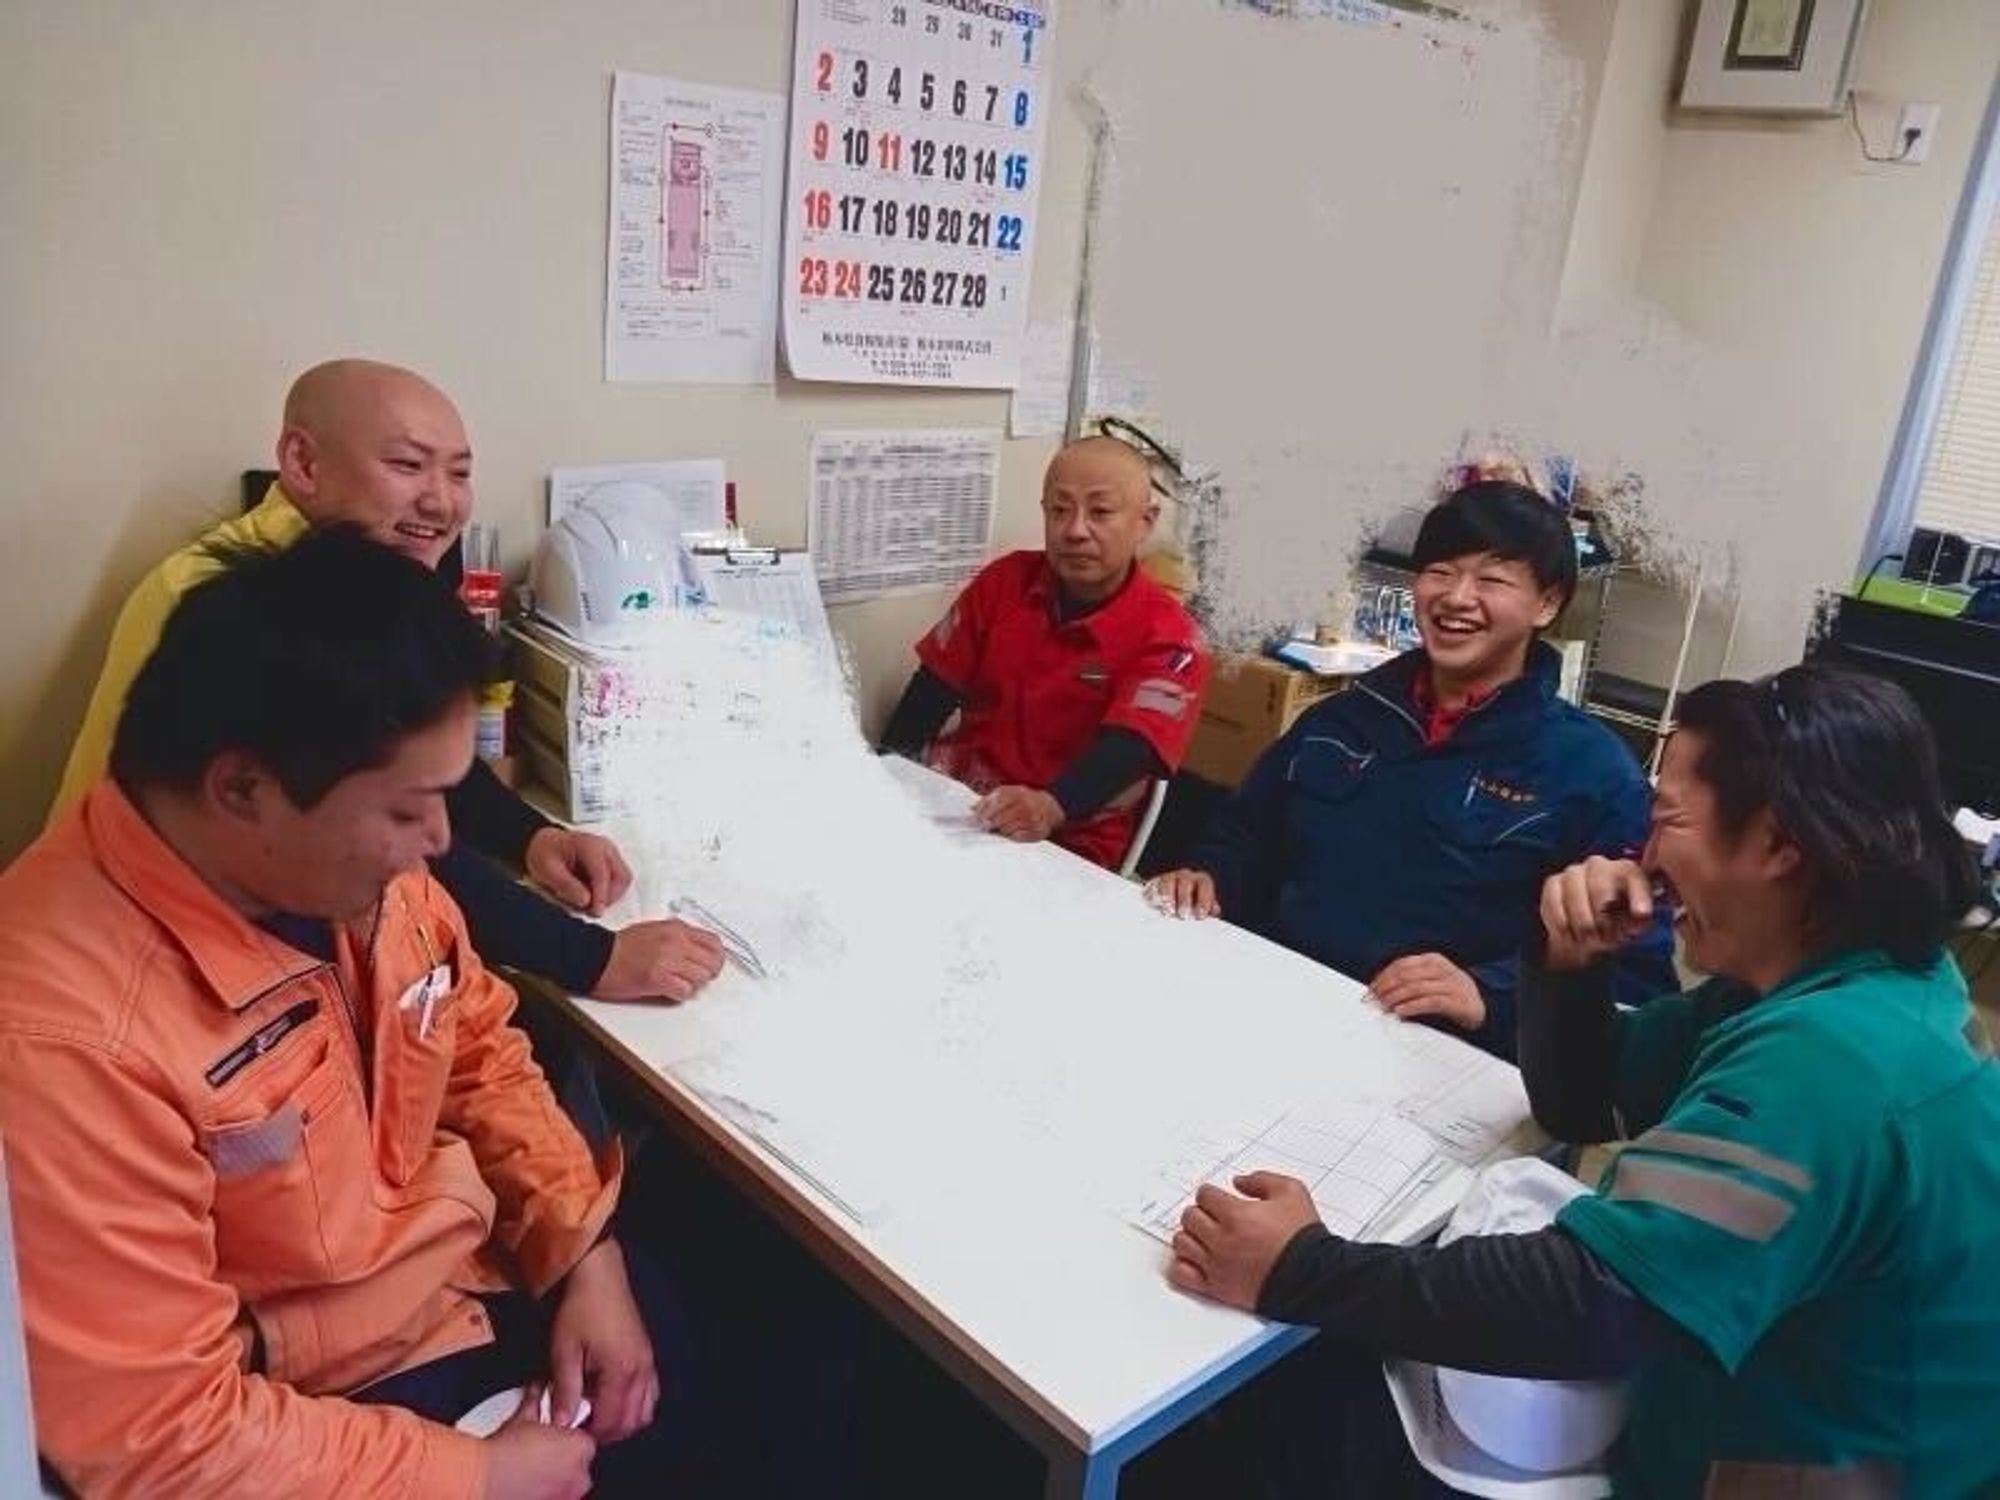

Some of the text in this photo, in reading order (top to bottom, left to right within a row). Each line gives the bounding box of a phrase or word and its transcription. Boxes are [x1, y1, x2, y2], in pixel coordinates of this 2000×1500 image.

[892, 7, 906, 27] 28
[925, 15, 940, 34] 29
[957, 22, 972, 41] 30
[990, 30, 1003, 48] 31
[1022, 29, 1034, 63] 1
[817, 53, 1029, 126] 2 3 4 5 6 7 8
[813, 122, 1028, 190] 9 10 11 12 13 14 15
[804, 191, 1022, 251] 16 17 18 19 20 21 22
[800, 257, 828, 296] 23
[834, 262, 861, 299] 24
[867, 265, 895, 301] 25
[899, 268, 927, 304] 26
[931, 272, 959, 306] 27
[960, 274, 987, 309] 28
